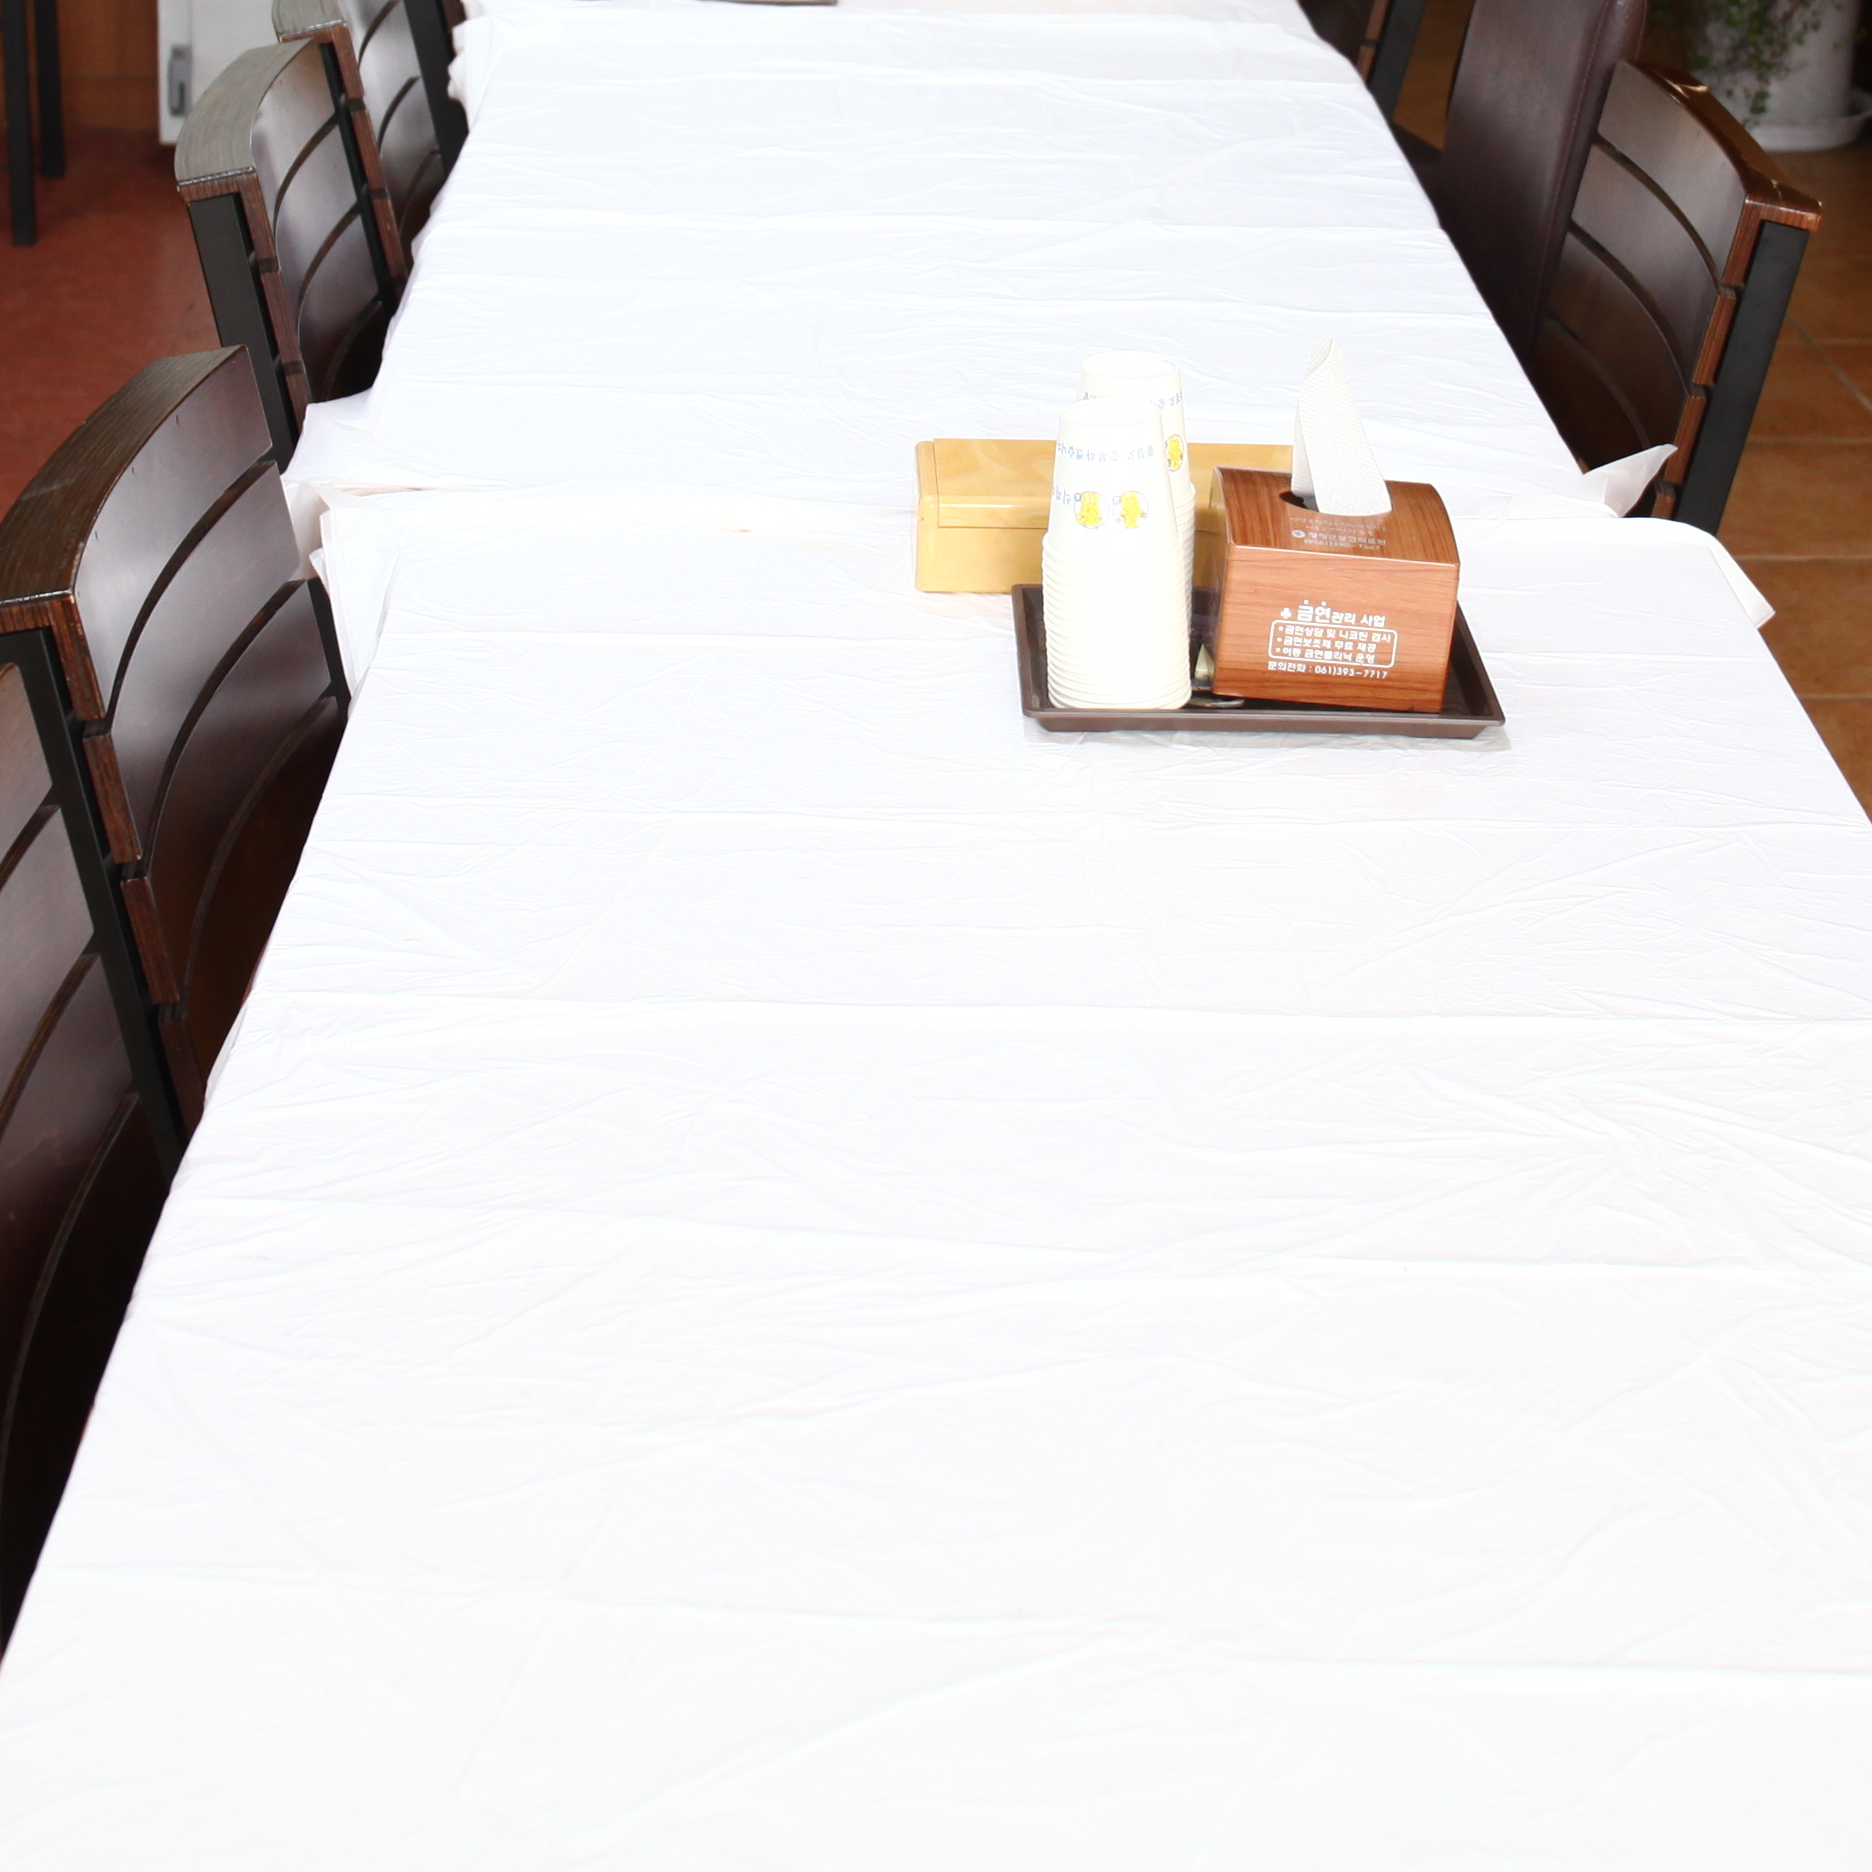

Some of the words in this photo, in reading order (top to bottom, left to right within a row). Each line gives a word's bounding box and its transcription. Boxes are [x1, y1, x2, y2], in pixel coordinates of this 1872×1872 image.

[1297, 604, 1356, 625] 금연관리
[1360, 614, 1386, 627] 사업
[1284, 625, 1324, 637] 금연상담
[1326, 628, 1336, 639] 및
[1339, 629, 1368, 641] 니코틴
[1371, 632, 1392, 643] 검사
[1283, 636, 1331, 649] 금연보조제
[1334, 640, 1354, 651] 무료
[1357, 642, 1377, 653] 제공
[1304, 649, 1352, 662] 금연클리닉
[1267, 660, 1306, 673] 문의전화
